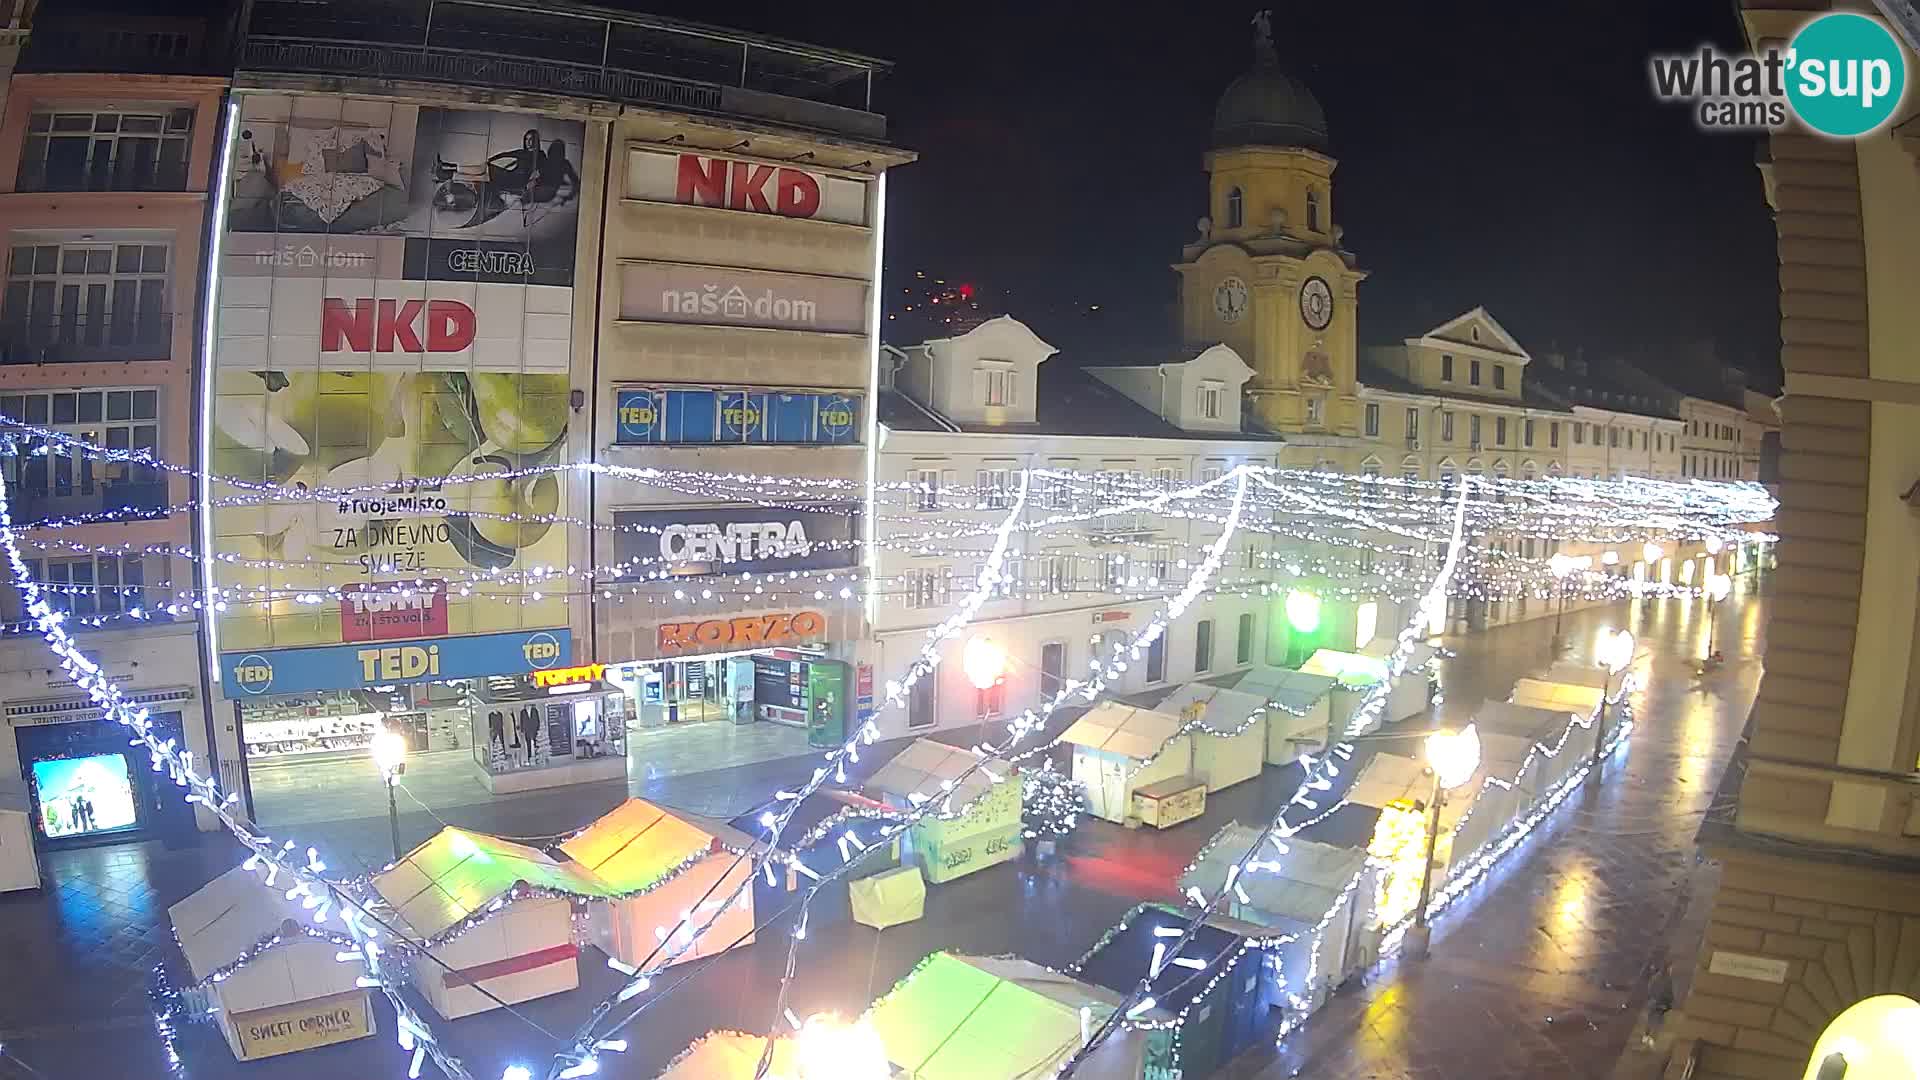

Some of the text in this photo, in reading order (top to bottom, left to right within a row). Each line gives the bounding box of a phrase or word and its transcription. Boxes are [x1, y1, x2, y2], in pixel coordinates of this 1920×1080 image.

[675, 153, 821, 219] NKD
[319, 247, 367, 268] dom
[448, 249, 535, 275] CENTRA
[662, 285, 816, 322] naš dom
[321, 297, 477, 353] NKD
[619, 407, 658, 425] TEDi
[723, 409, 760, 425] TEDi
[820, 410, 853, 426] TEDi
[334, 523, 450, 548] ZA DNEVNO
[659, 520, 810, 563] CENTRA
[360, 547, 426, 574] SVJEŽE
[658, 611, 826, 651] KORZO
[523, 640, 560, 660] TEDi
[234, 665, 273, 684] TEDi
[358, 645, 440, 682] TEDi
[533, 663, 605, 687] TOMMY
[250, 1021, 293, 1041] SWEET
